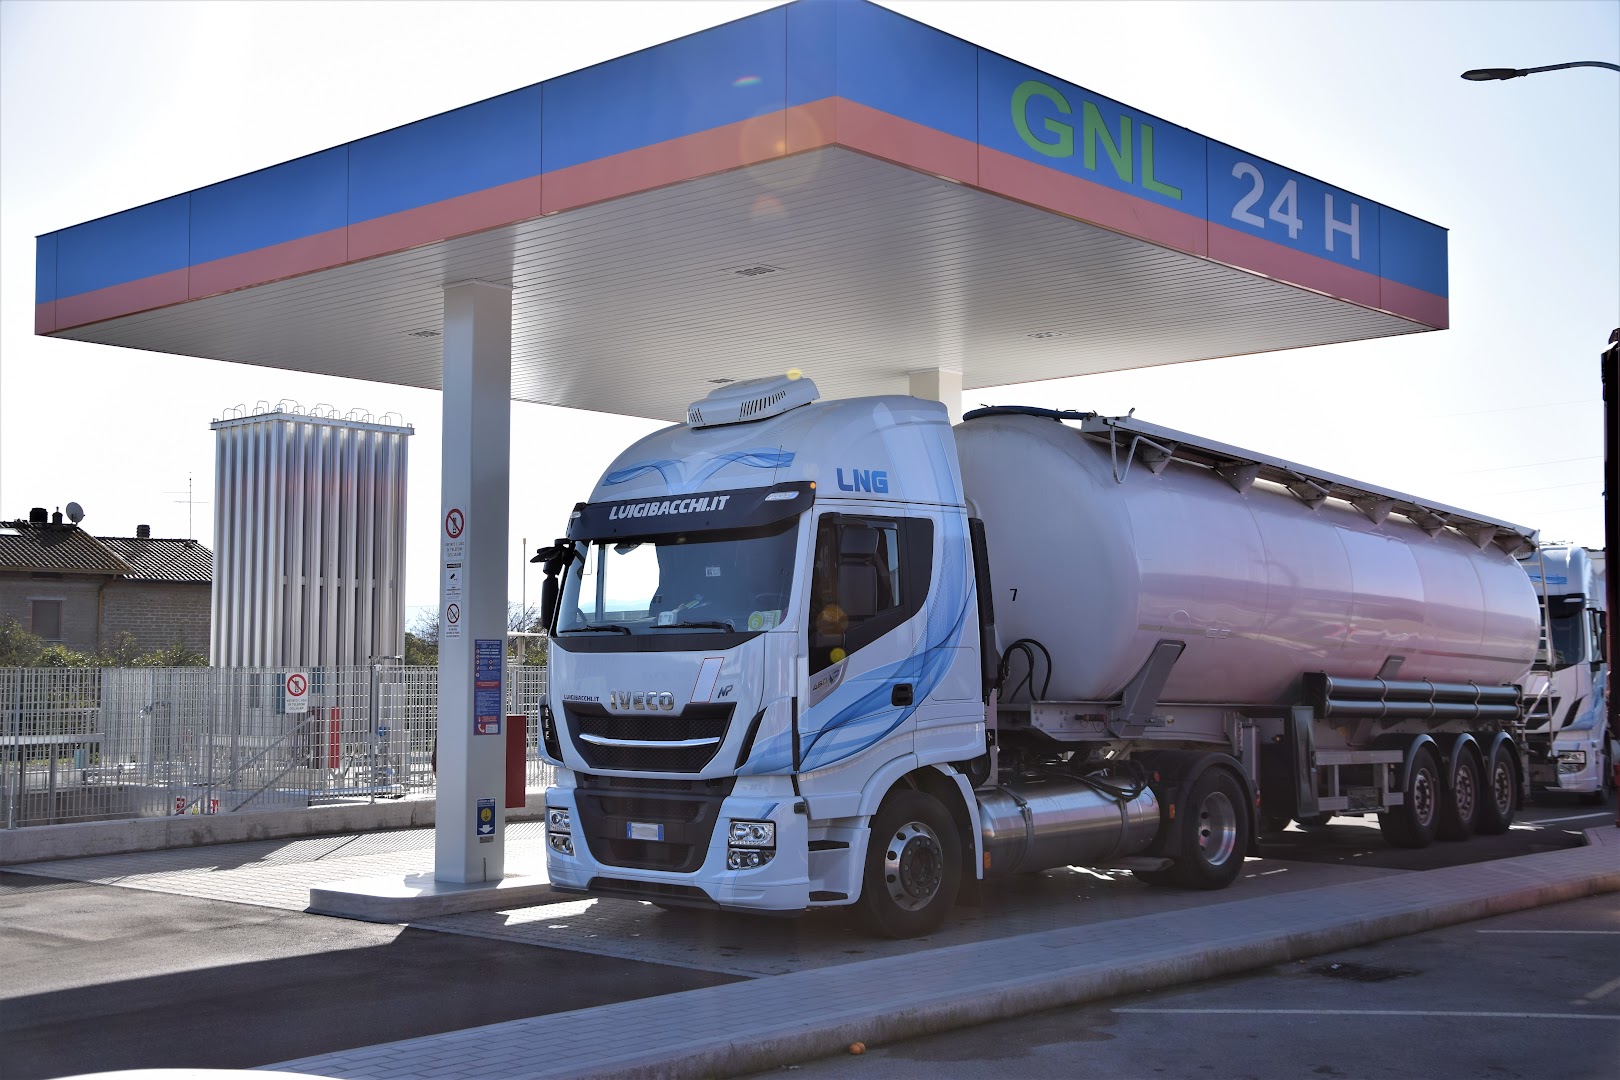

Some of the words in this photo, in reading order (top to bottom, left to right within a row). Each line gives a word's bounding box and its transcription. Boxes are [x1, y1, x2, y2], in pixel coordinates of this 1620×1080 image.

[1010, 80, 1182, 200] GNL
[1231, 161, 1303, 240] 24
[1324, 192, 1360, 260] H
[836, 467, 889, 494] LNG
[608, 495, 730, 520] LUIGIBACCHI.IT
[1009, 588, 1018, 602] 7
[563, 694, 600, 702] LUIGIBACCHI.IT
[610, 691, 675, 711] IVECO
